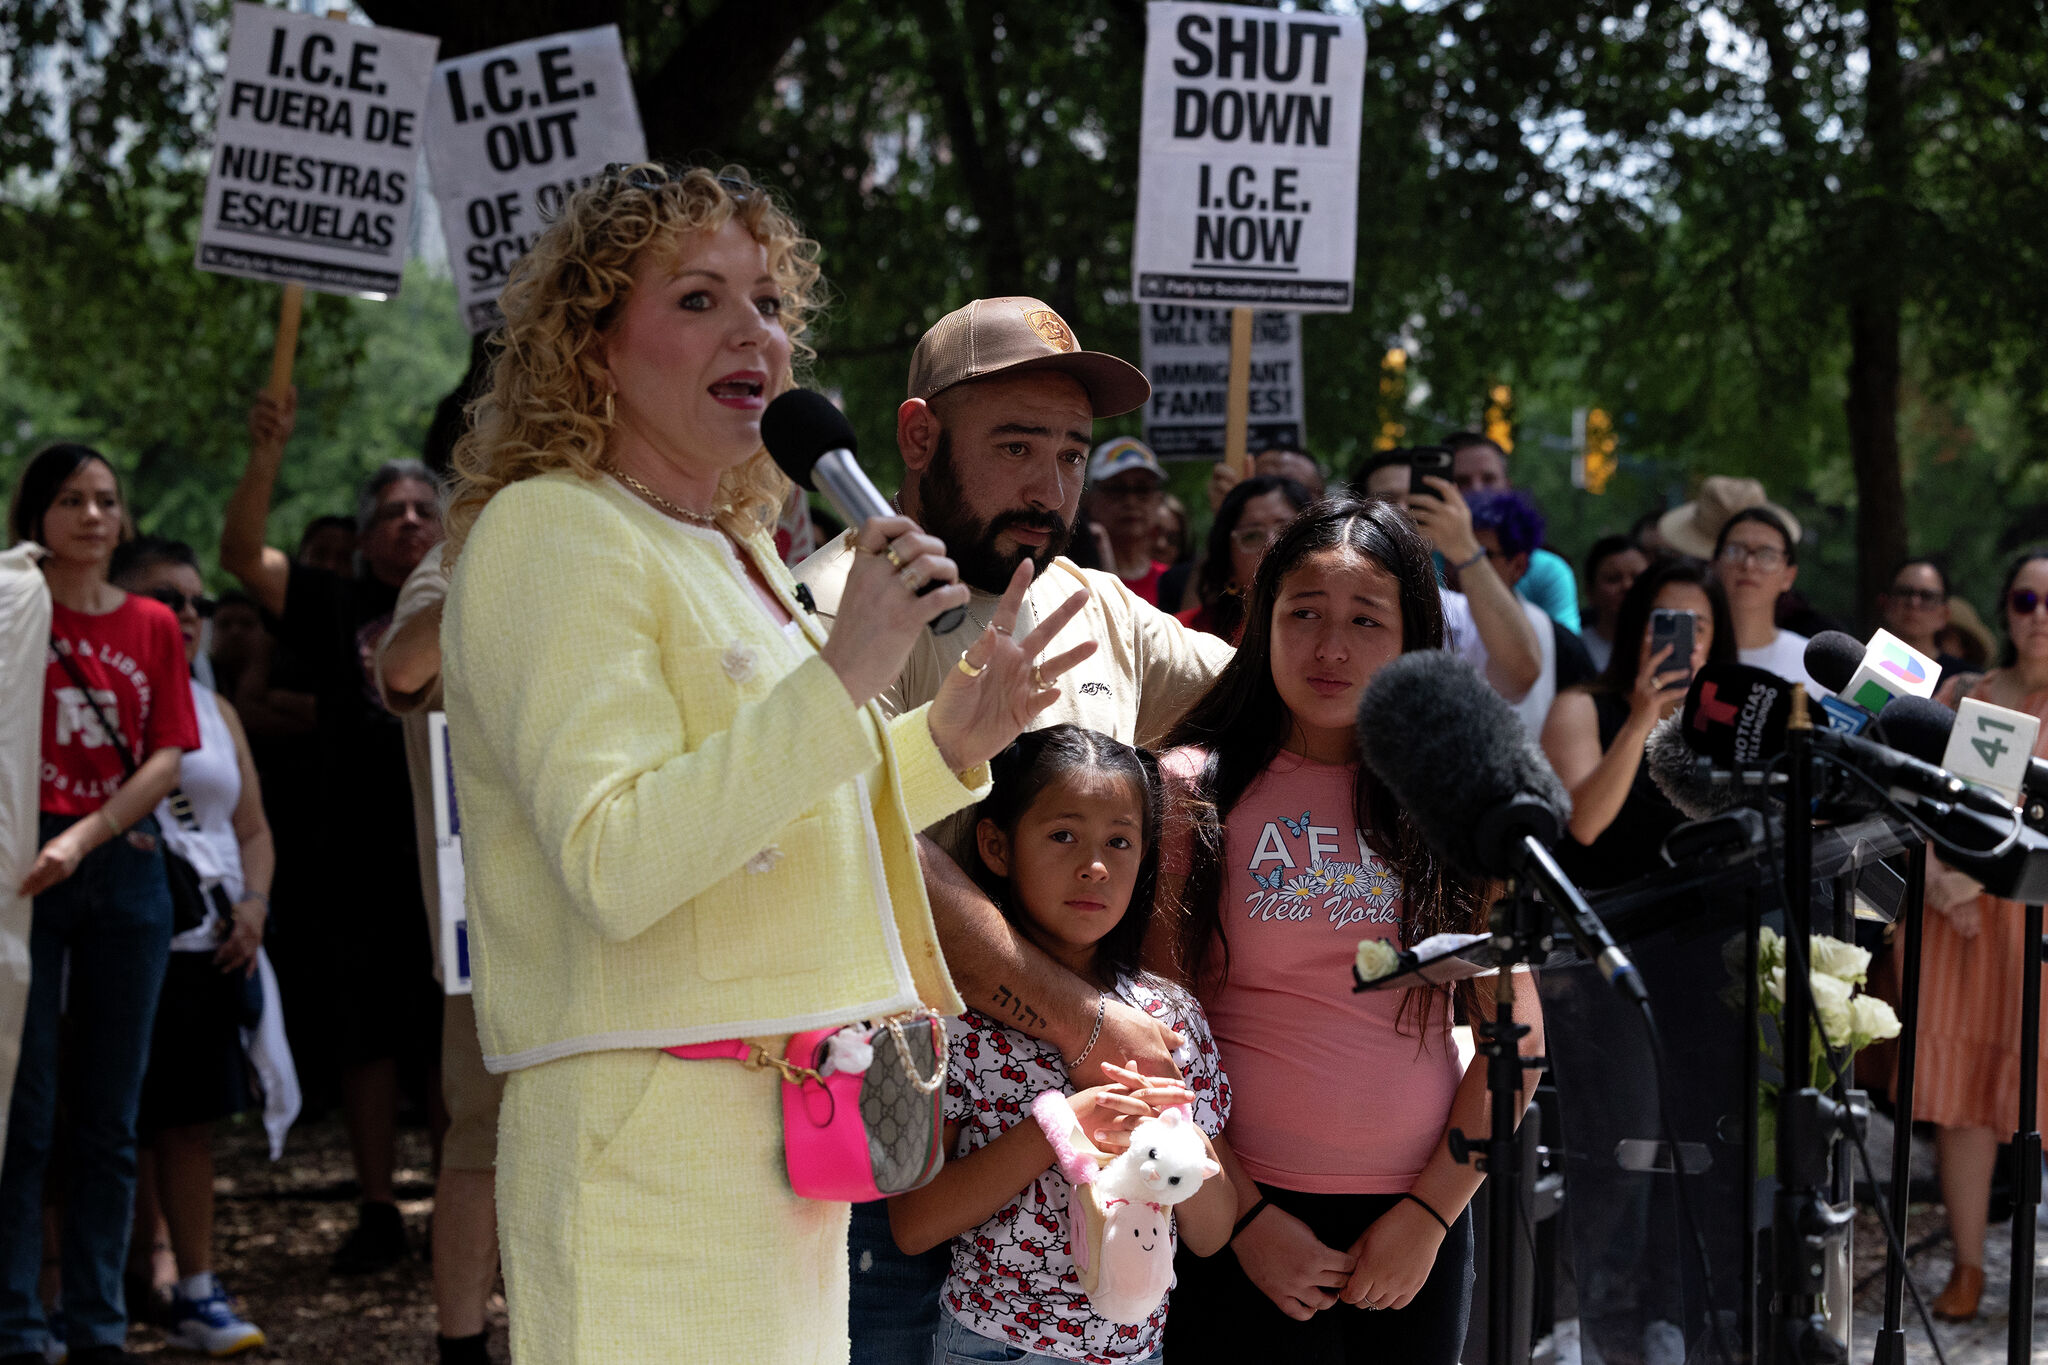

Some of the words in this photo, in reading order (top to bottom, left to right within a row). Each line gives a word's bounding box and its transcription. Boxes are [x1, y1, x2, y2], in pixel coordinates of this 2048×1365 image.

[268, 28, 387, 96] I.C.E.
[1173, 14, 1341, 85] SHUT
[229, 81, 352, 139] FUERA
[365, 104, 417, 148] DE
[445, 45, 597, 125] I.C.E.
[485, 111, 580, 173] OUT
[1174, 87, 1331, 147] DOWN
[219, 144, 407, 206] NUESTRAS
[1198, 164, 1311, 213] I.C.E.
[218, 190, 396, 249] ESCUELAS
[467, 192, 521, 240] OF
[1195, 215, 1302, 263] NOW
[1734, 682, 1767, 763] NOTICIAS
[1970, 716, 2016, 768] 41
[1245, 890, 1312, 922] New
[1322, 895, 1398, 931] York
